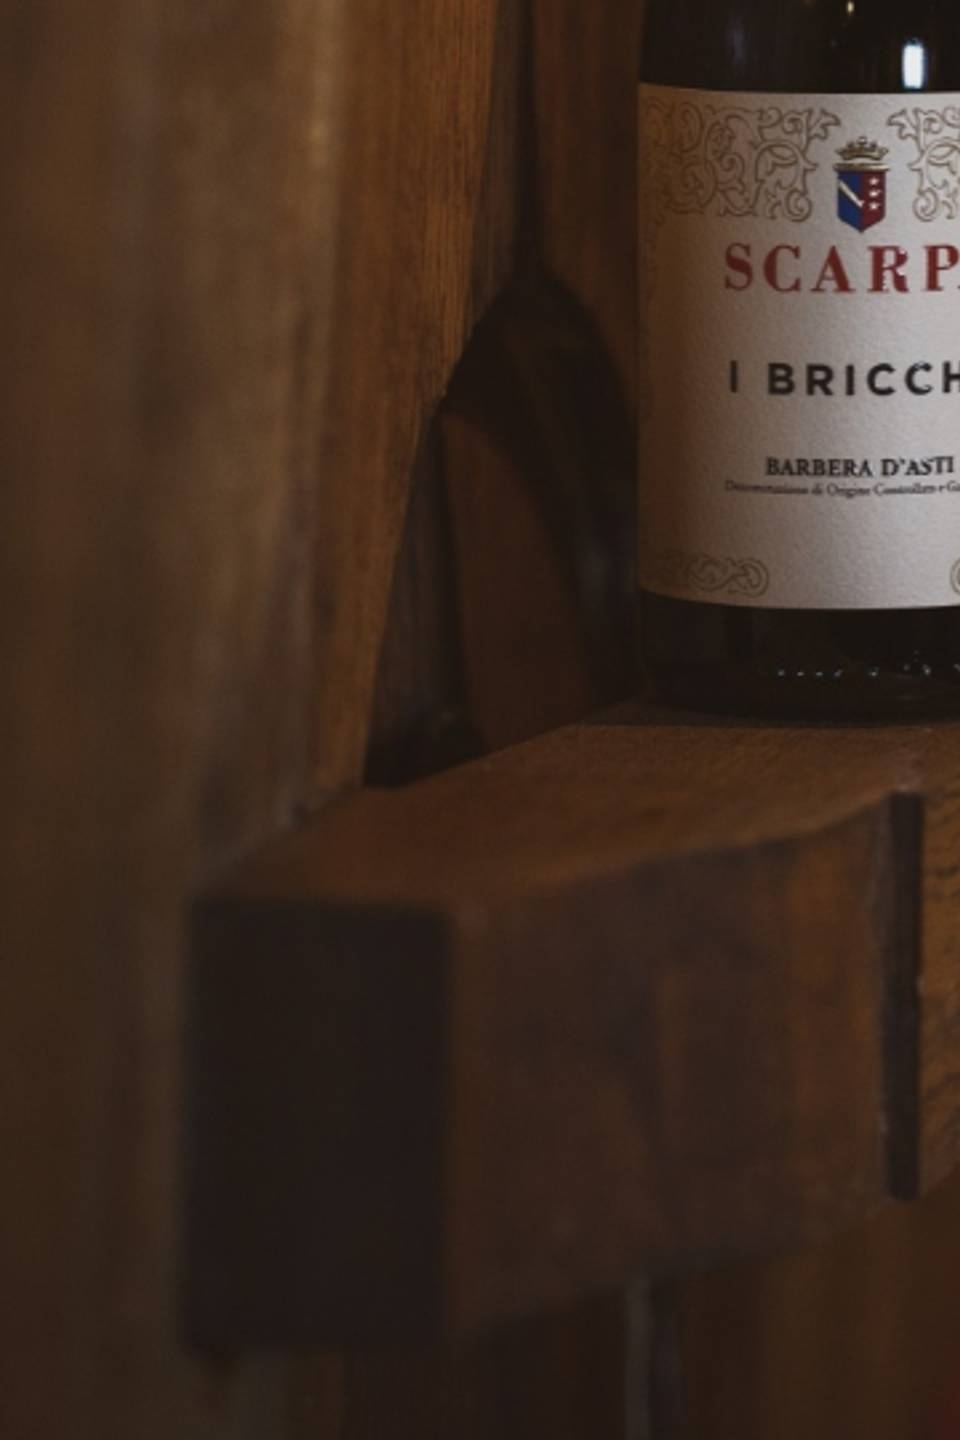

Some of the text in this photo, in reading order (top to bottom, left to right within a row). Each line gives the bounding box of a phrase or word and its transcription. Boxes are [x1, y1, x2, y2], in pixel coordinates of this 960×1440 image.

[729, 361, 738, 393] I
[766, 456, 955, 477] BARBERA D'ASTI
